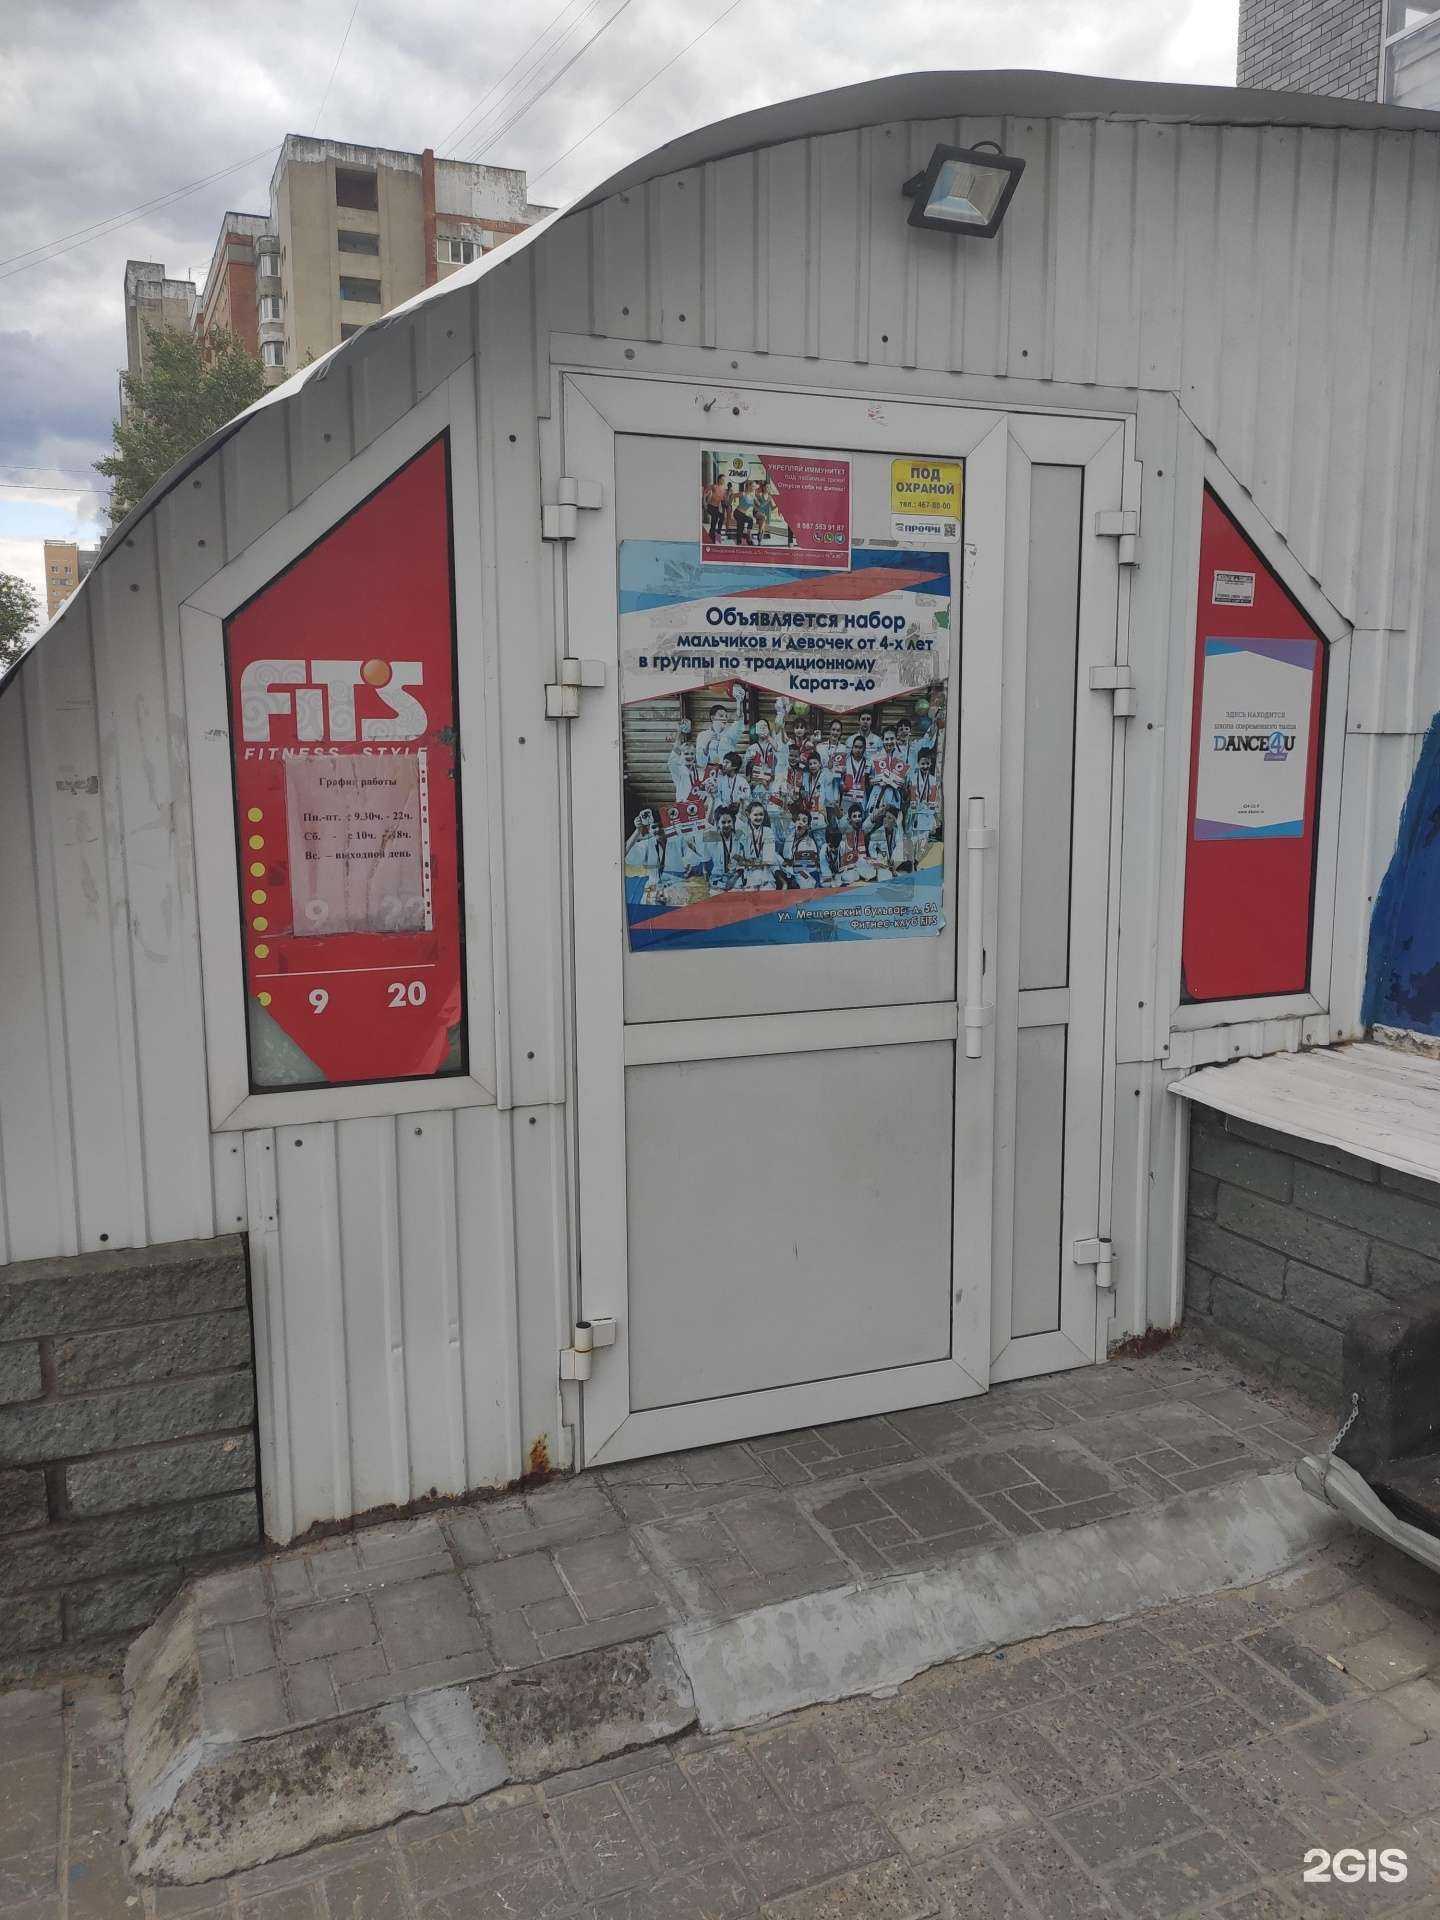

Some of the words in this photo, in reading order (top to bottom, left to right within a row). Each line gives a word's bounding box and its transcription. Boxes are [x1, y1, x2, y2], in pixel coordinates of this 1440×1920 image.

[910, 467, 941, 482] ПОД
[895, 481, 955, 495] ОХРАНОЙ
[705, 607, 839, 628] Объявляется
[844, 611, 906, 633] набор
[677, 634, 768, 650] мальчиков
[771, 636, 782, 649] и
[786, 637, 853, 652] девочек
[857, 638, 876, 650] от
[879, 637, 903, 650] 4-х
[906, 639, 934, 652] лет
[638, 656, 648, 668] в
[653, 655, 715, 672] группы
[719, 657, 741, 669] по
[745, 657, 876, 674] традиционному
[788, 674, 876, 693] Каратэ-до
[1213, 731, 1296, 755] DANCE4U
[244, 747, 340, 760] FITNESS
[361, 776, 397, 788] работы
[392, 811, 413, 821] 22ч.
[304, 831, 321, 841] Сб.
[355, 830, 377, 840] 10ч.
[305, 850, 321, 861] Вс.
[335, 849, 385, 860] выходной
[389, 850, 412, 859] день
[777, 911, 793, 922] ул.
[795, 905, 864, 920] Мещерский
[850, 916, 918, 930] Фитнес-клуб
[308, 988, 329, 1014] 9
[388, 980, 427, 1008] 20
